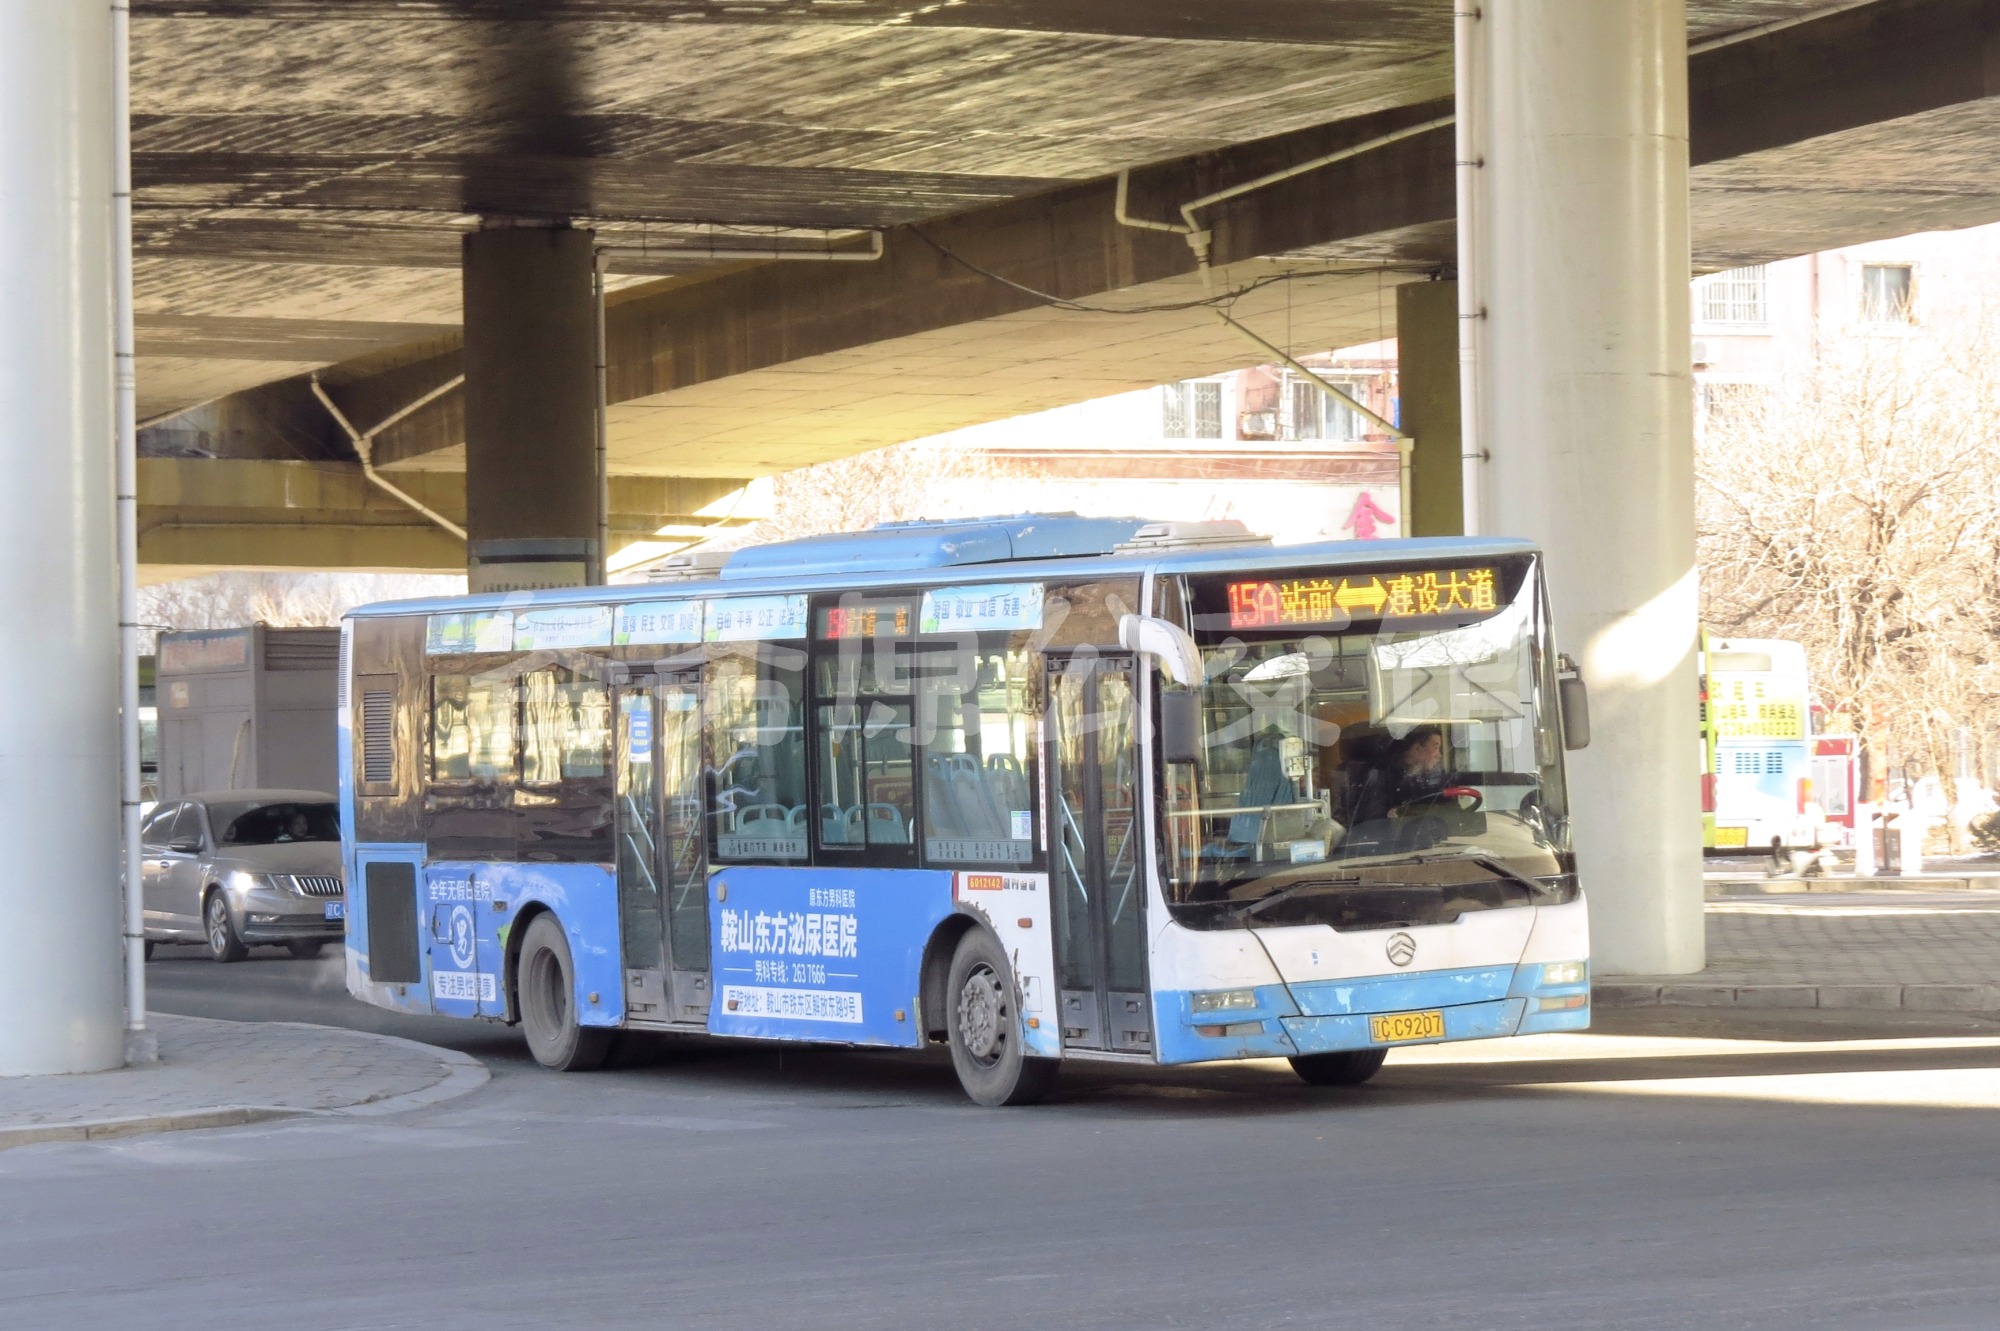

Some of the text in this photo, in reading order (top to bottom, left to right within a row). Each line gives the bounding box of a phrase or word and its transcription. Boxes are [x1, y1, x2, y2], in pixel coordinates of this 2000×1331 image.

[1229, 569, 1496, 628] 15A 站前 建设大道
[430, 880, 490, 900] 全年无假日医院
[969, 877, 1001, 888] 6012142
[809, 888, 856, 908] 原东方男科医院
[721, 909, 857, 958] 鞍山东方泌尿医院
